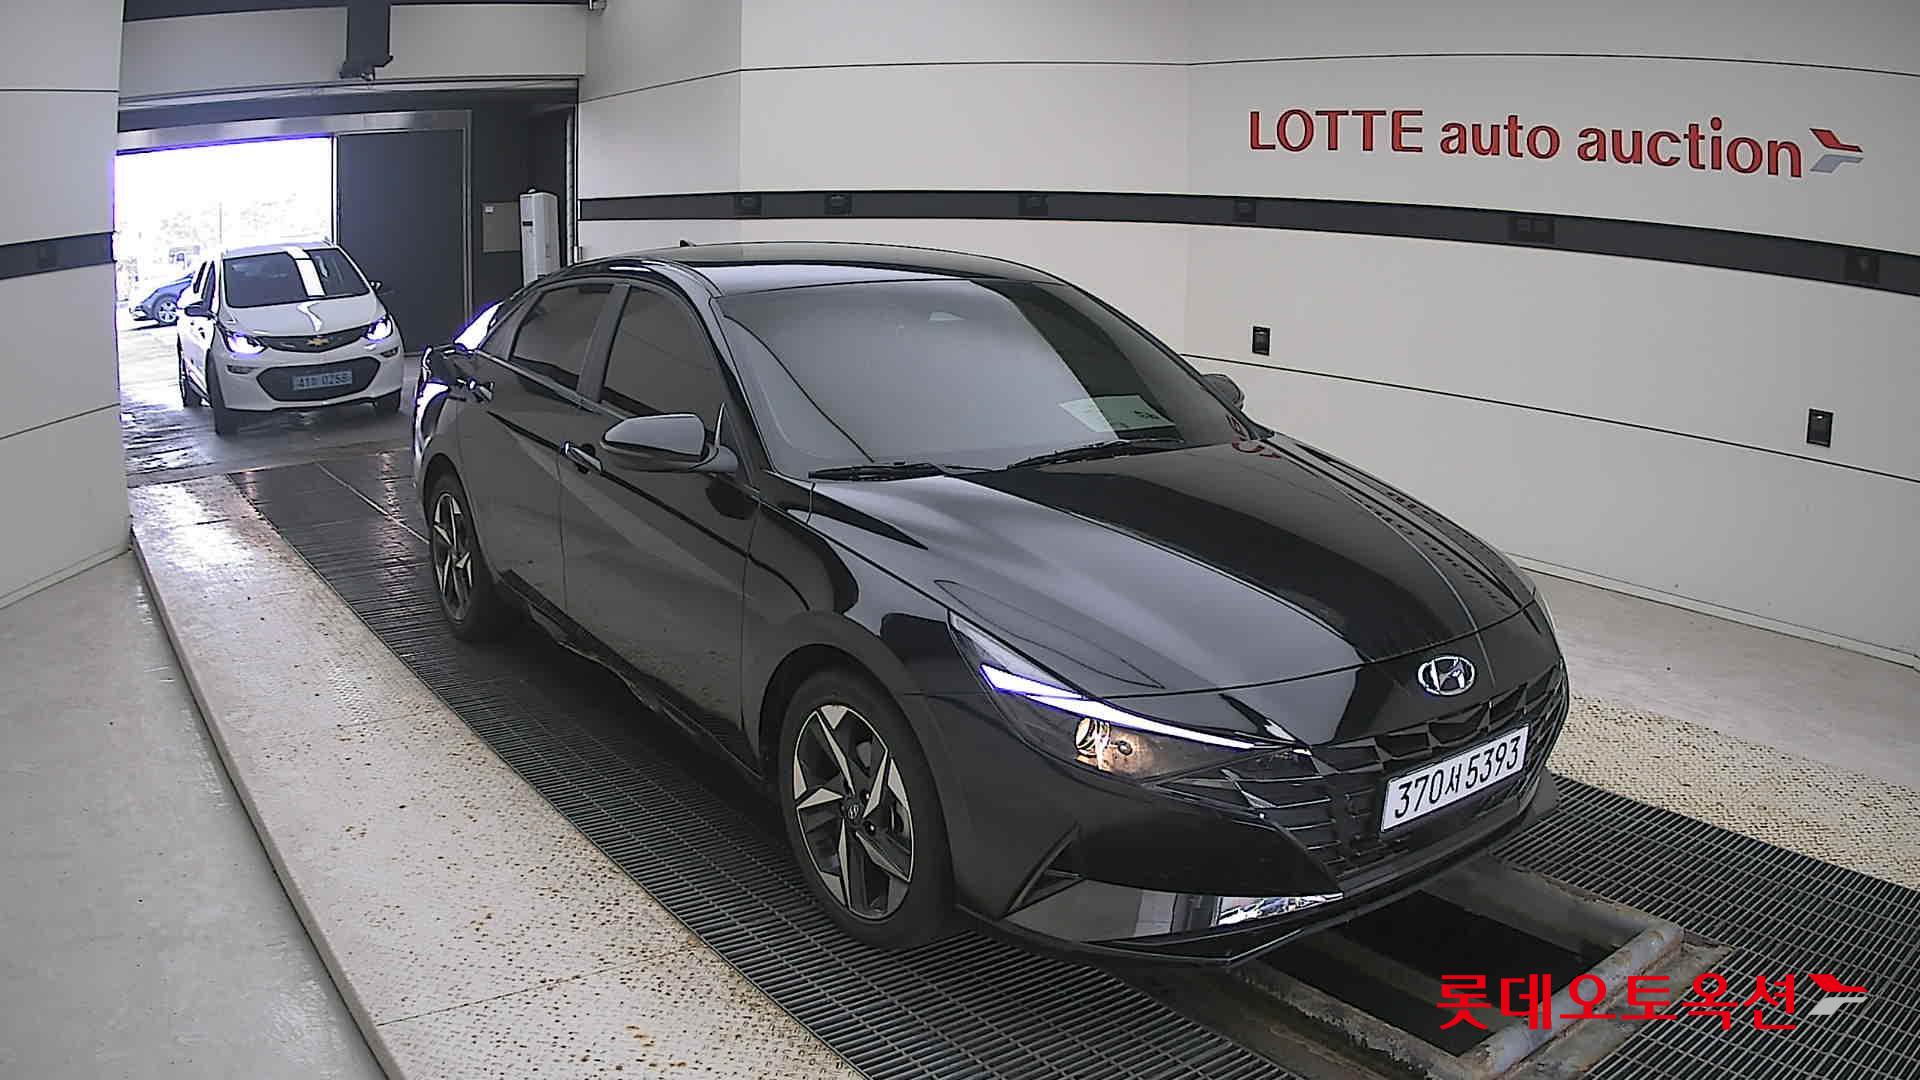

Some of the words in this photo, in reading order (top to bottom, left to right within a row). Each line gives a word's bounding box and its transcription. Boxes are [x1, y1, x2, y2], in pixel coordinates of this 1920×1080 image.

[1249, 110, 1424, 153] LOTTE
[1440, 114, 1561, 159] auto
[1576, 116, 1803, 178] auction
